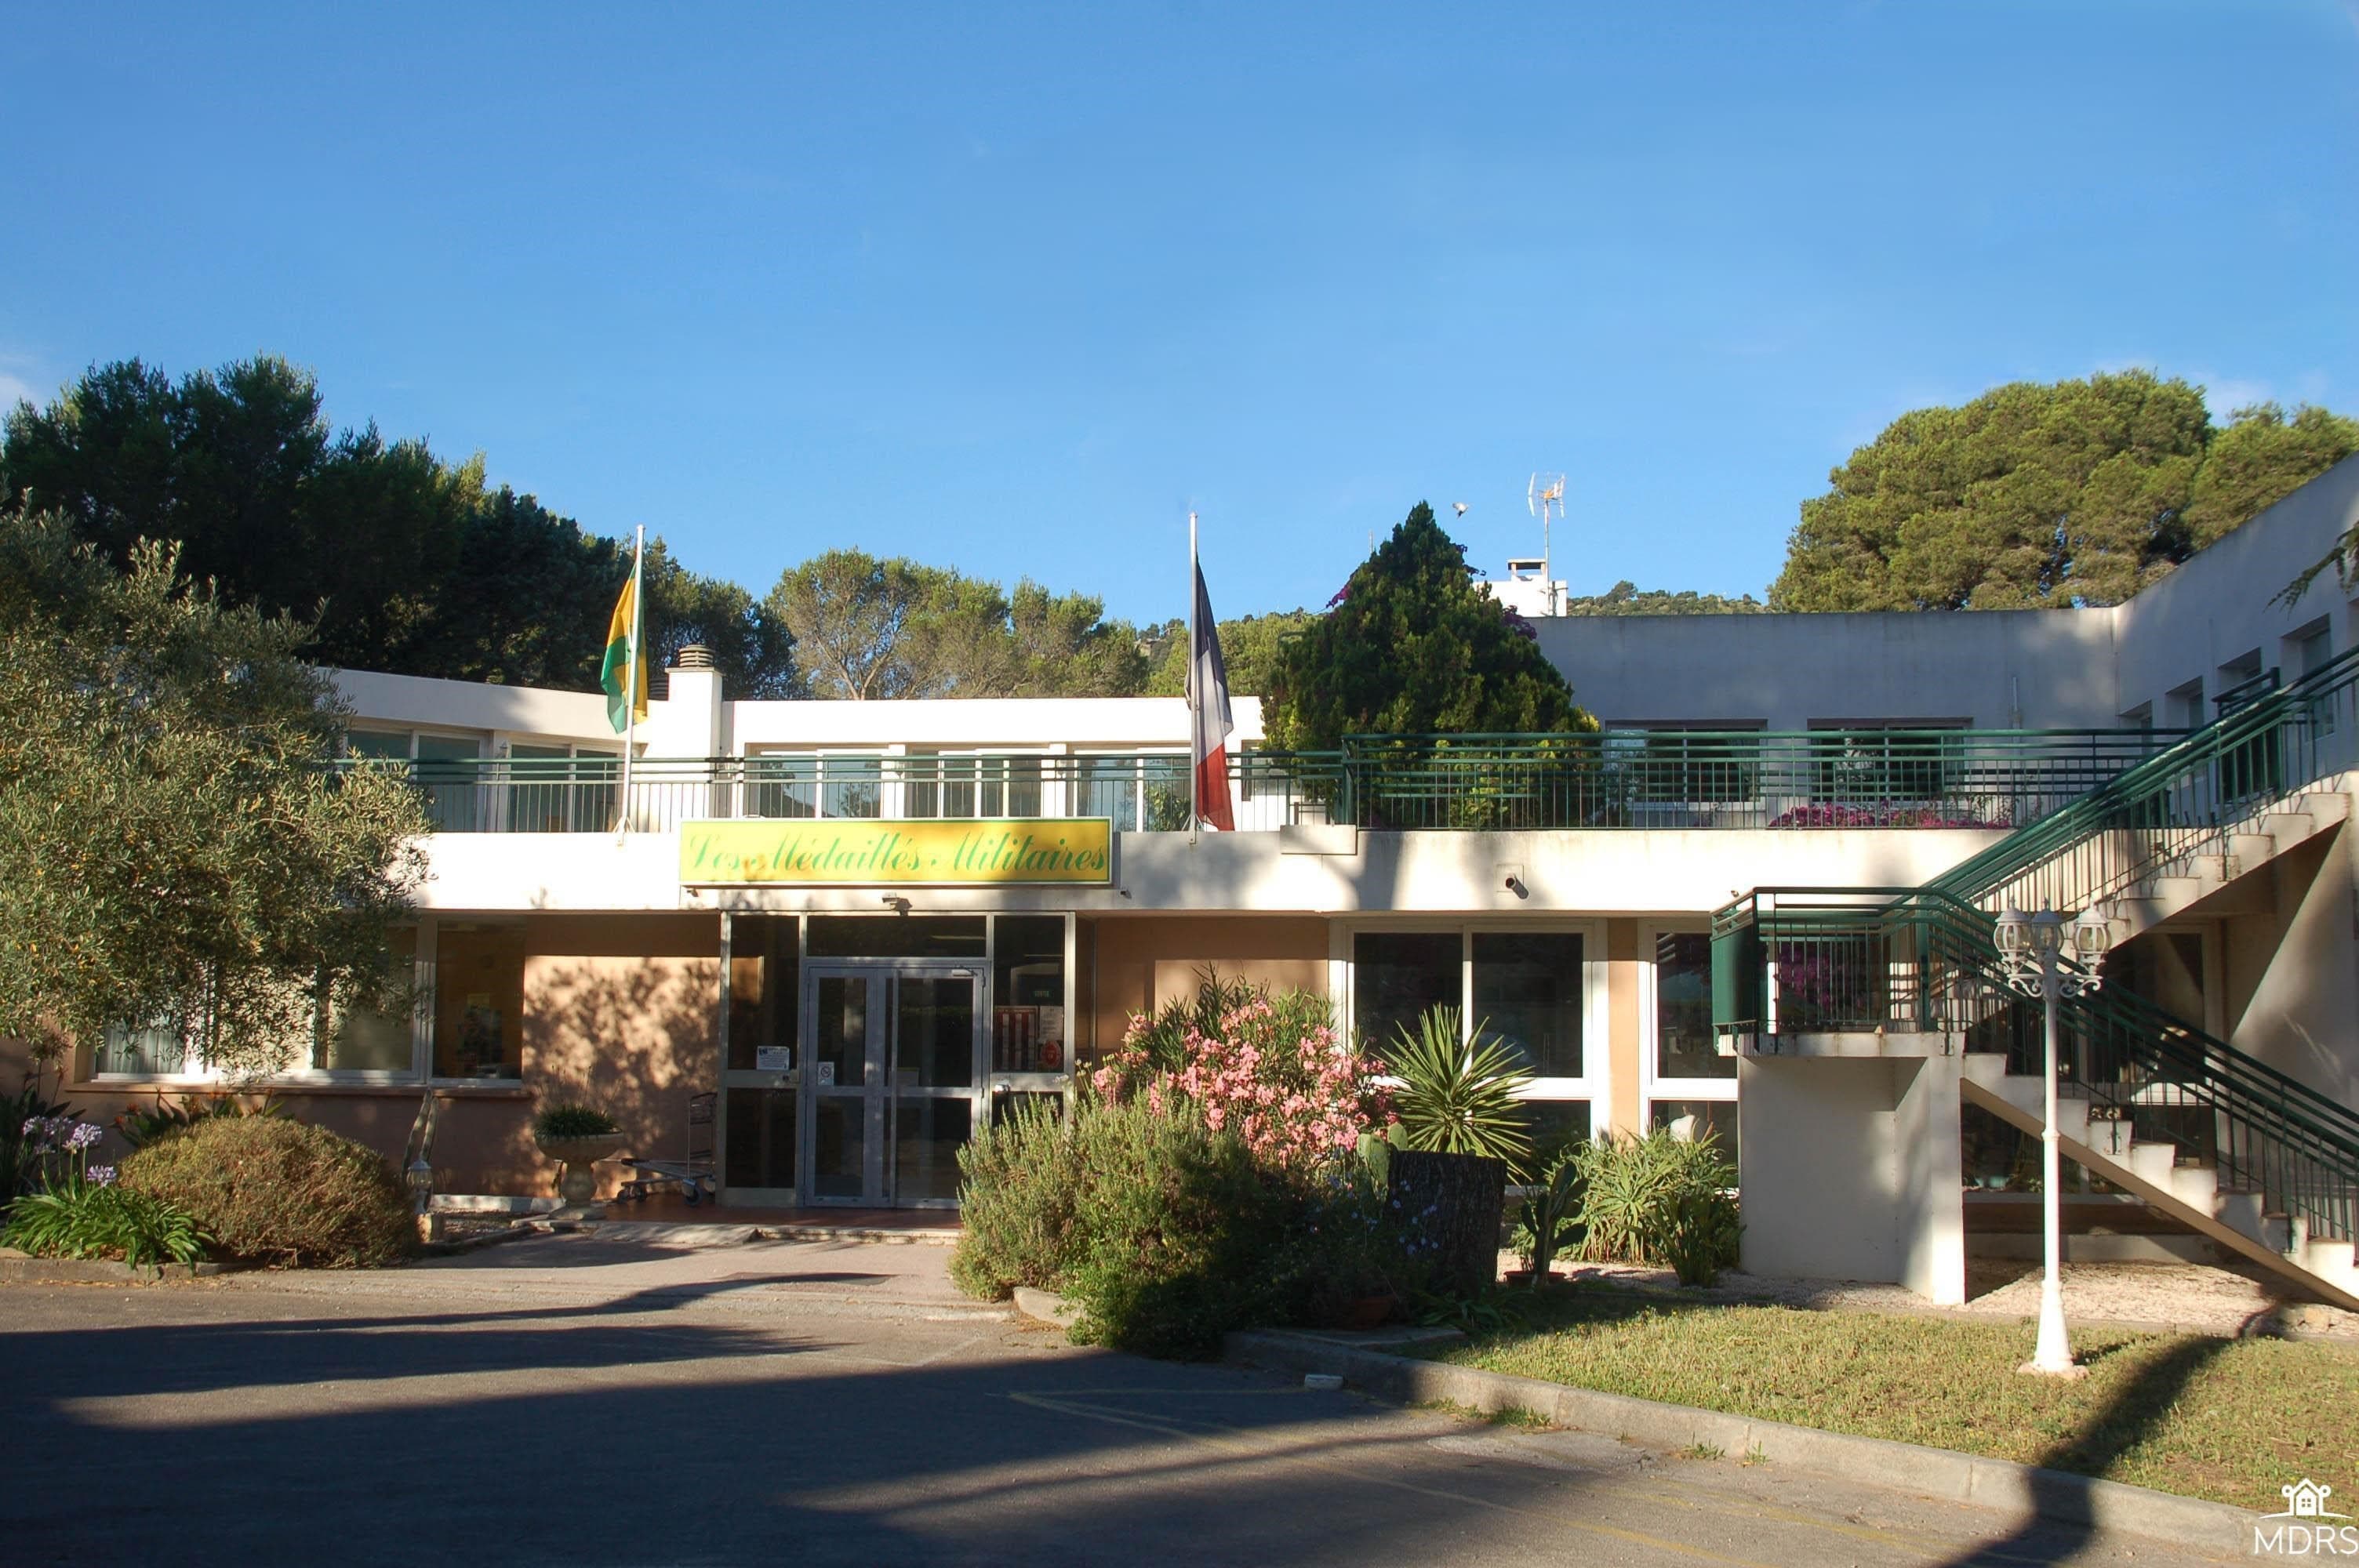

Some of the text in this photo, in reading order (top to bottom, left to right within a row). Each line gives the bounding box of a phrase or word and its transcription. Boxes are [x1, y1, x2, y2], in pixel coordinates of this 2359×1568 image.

[689, 831, 1105, 871] Les Médaillés Militaires
